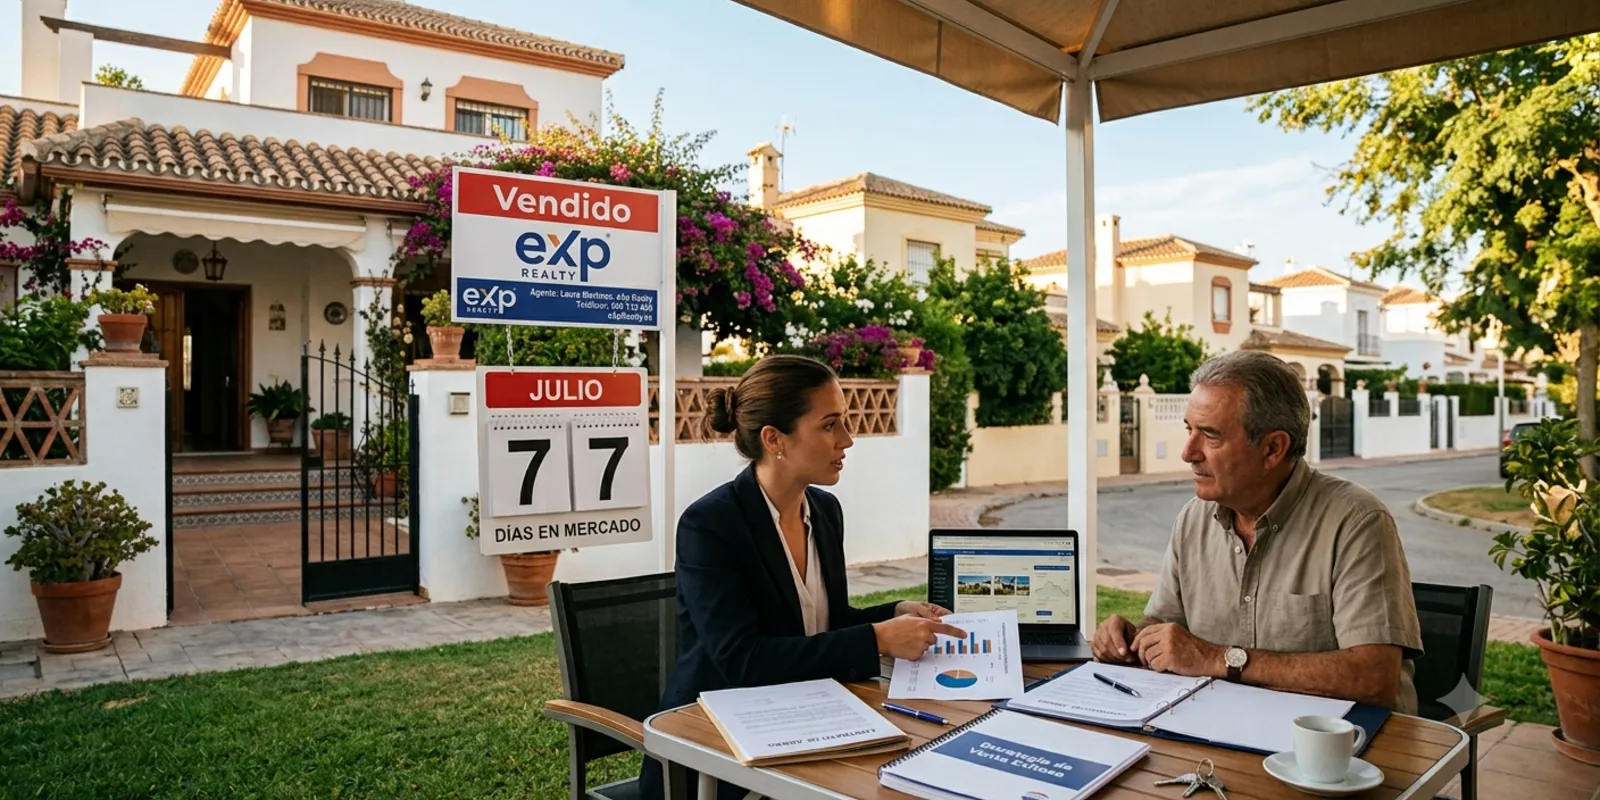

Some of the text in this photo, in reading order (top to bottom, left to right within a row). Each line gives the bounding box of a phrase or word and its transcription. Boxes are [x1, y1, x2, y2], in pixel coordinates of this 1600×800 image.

[493, 184, 632, 223] Vendido
[521, 268, 576, 281] REALTY
[530, 288, 559, 299] Agente:
[560, 290, 581, 299] Laura
[529, 379, 603, 401] JULIO
[508, 437, 629, 506] 7 7
[495, 518, 641, 543] DÍAS EN MERCADO
